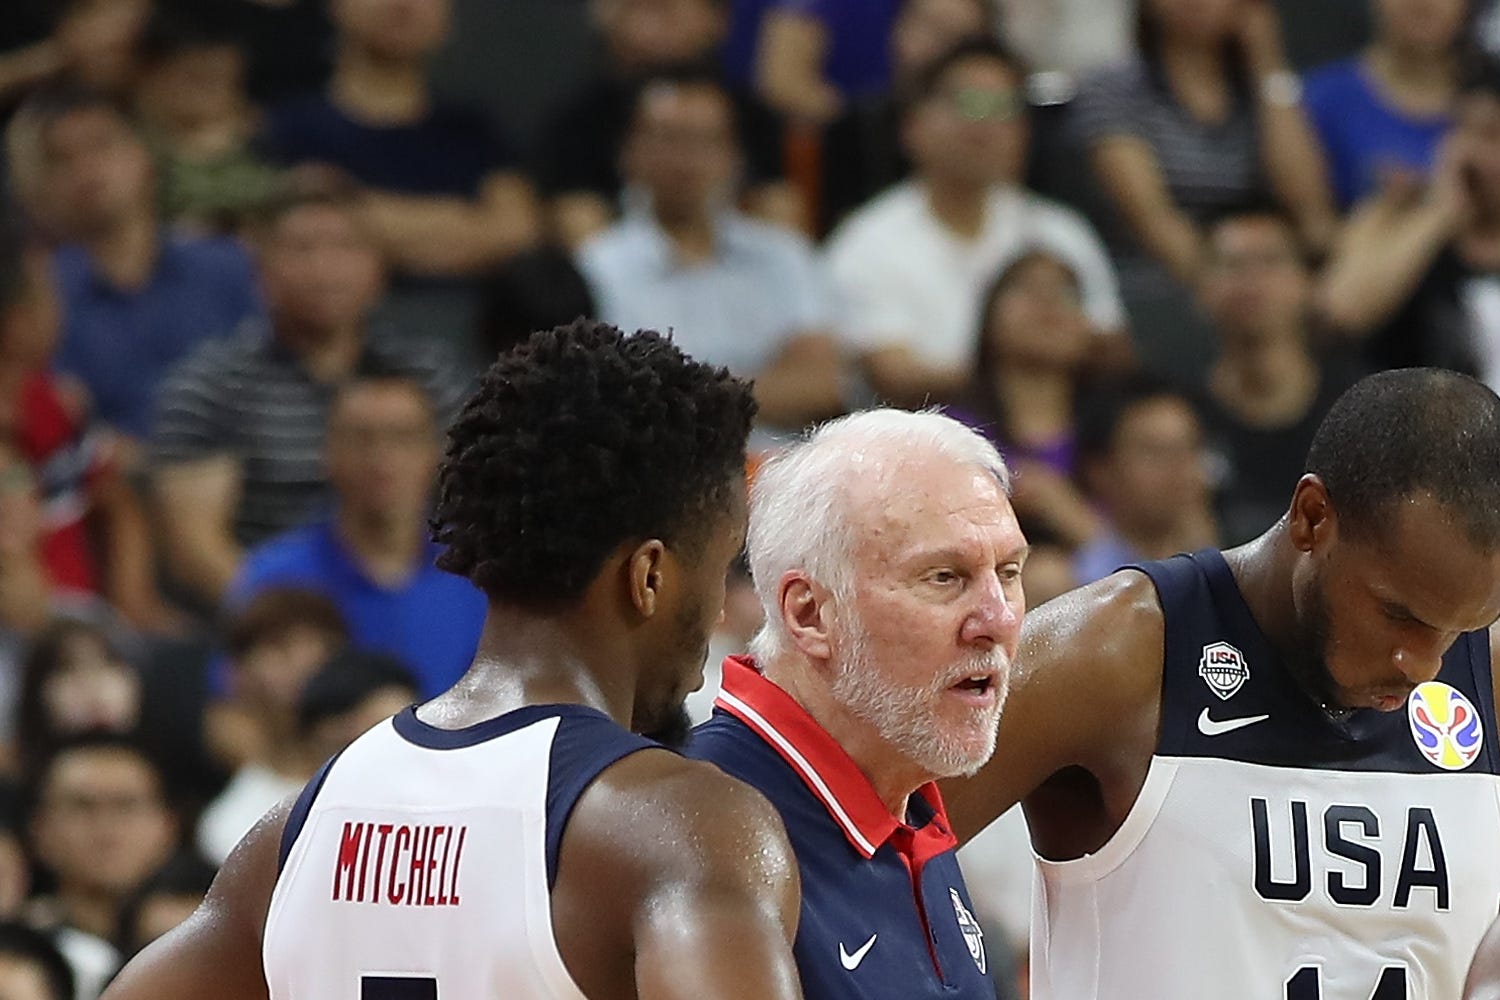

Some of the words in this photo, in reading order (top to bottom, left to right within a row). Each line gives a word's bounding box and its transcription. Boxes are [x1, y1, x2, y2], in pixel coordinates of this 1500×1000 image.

[1209, 651, 1239, 667] USA
[332, 821, 468, 906] MITCHELL
[1249, 796, 1452, 912] USA
